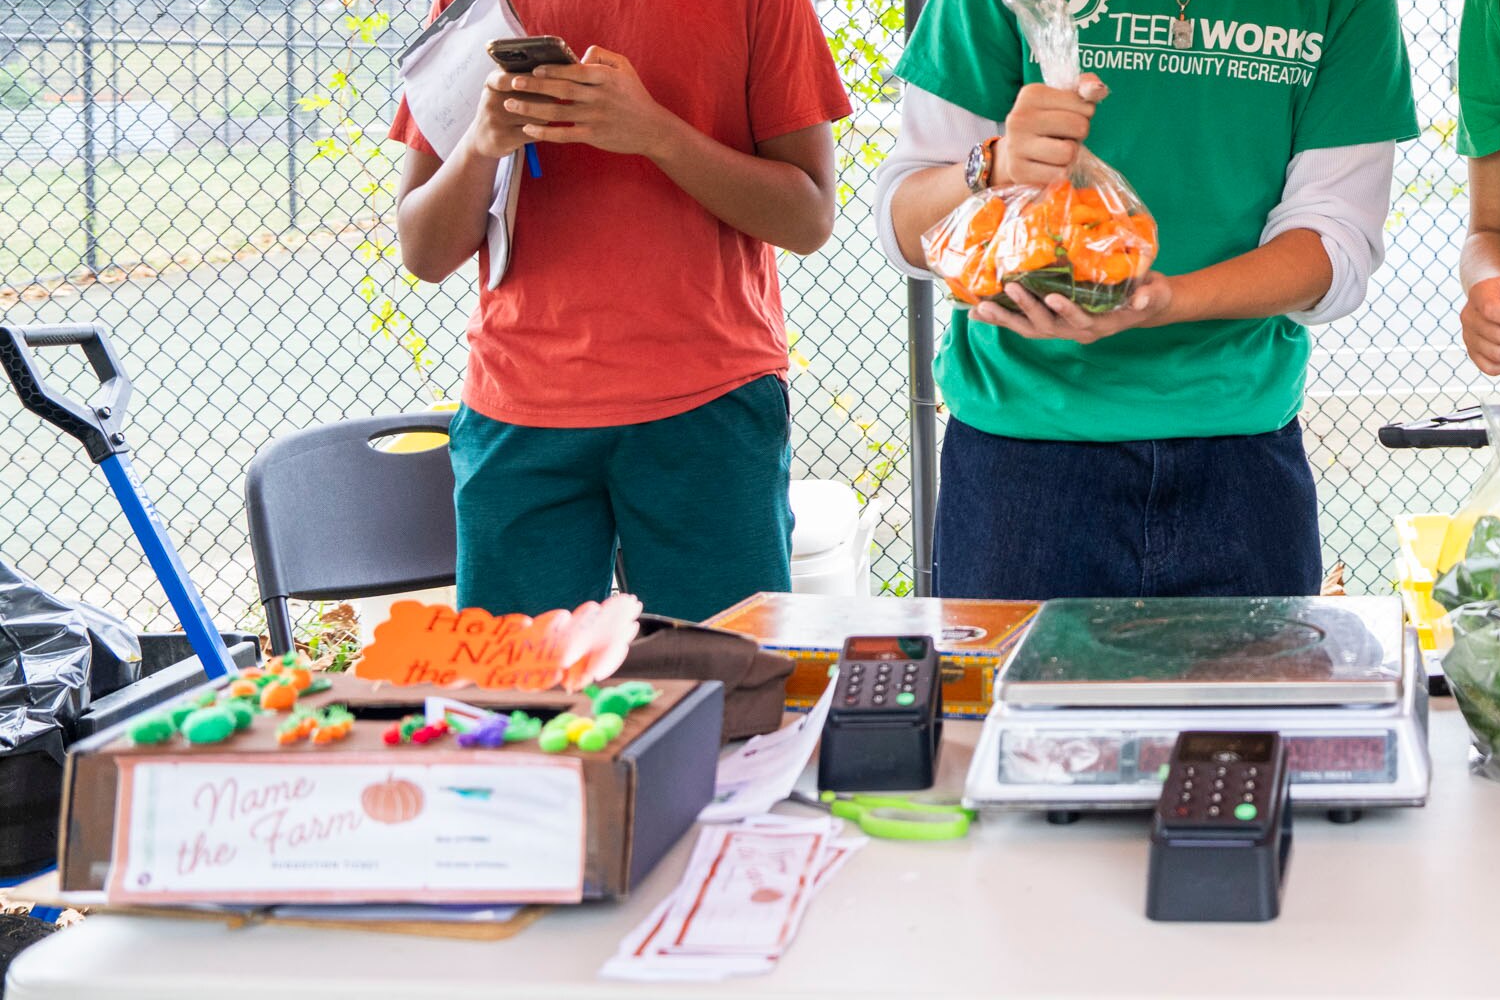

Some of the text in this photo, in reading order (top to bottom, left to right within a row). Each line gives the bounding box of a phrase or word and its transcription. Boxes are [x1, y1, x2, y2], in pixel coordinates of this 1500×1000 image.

[1158, 54, 1225, 77] COUNTY
[403, 659, 458, 685] the
[193, 777, 315, 825] Name
[177, 807, 365, 876] the Farm
